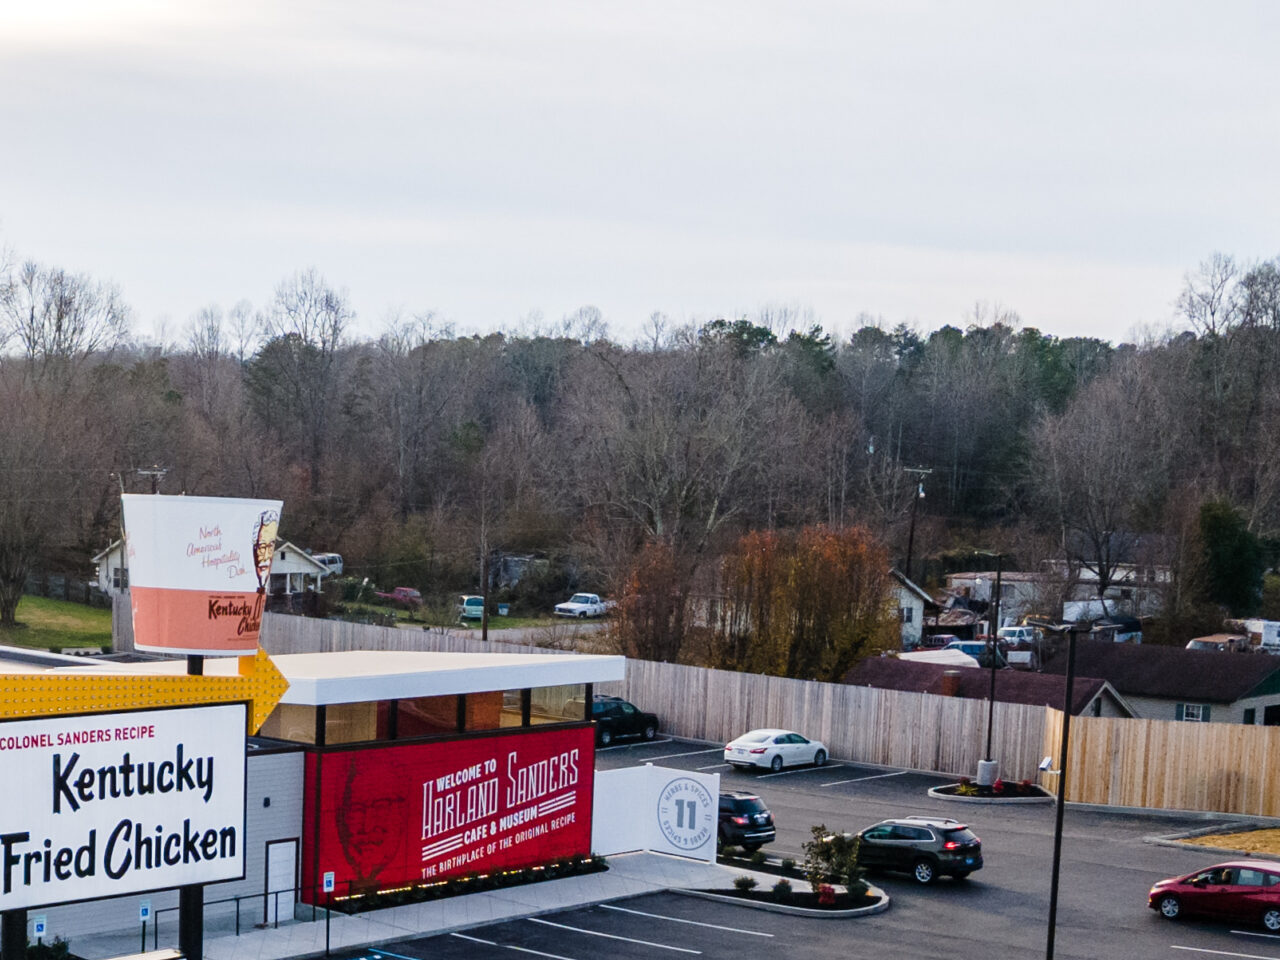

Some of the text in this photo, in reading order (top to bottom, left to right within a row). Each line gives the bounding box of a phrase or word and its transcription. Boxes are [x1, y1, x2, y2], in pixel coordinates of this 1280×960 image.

[208, 600, 252, 619] Kentucky
[0, 725, 155, 750] COLONEL SANDERS RECIPE
[52, 743, 214, 814] Kentucky
[436, 758, 497, 792] WELCOME TO
[421, 749, 579, 840] HARLAND SANDERS
[663, 784, 682, 801] HERBS
[691, 785, 709, 808] SPICES
[463, 805, 538, 845] CAFE & MUSEUM
[675, 799, 696, 830] 11
[104, 818, 236, 880] Chicken
[421, 812, 575, 879] THE BIRTHPLACE OF THE ORIGINAL RECIPE
